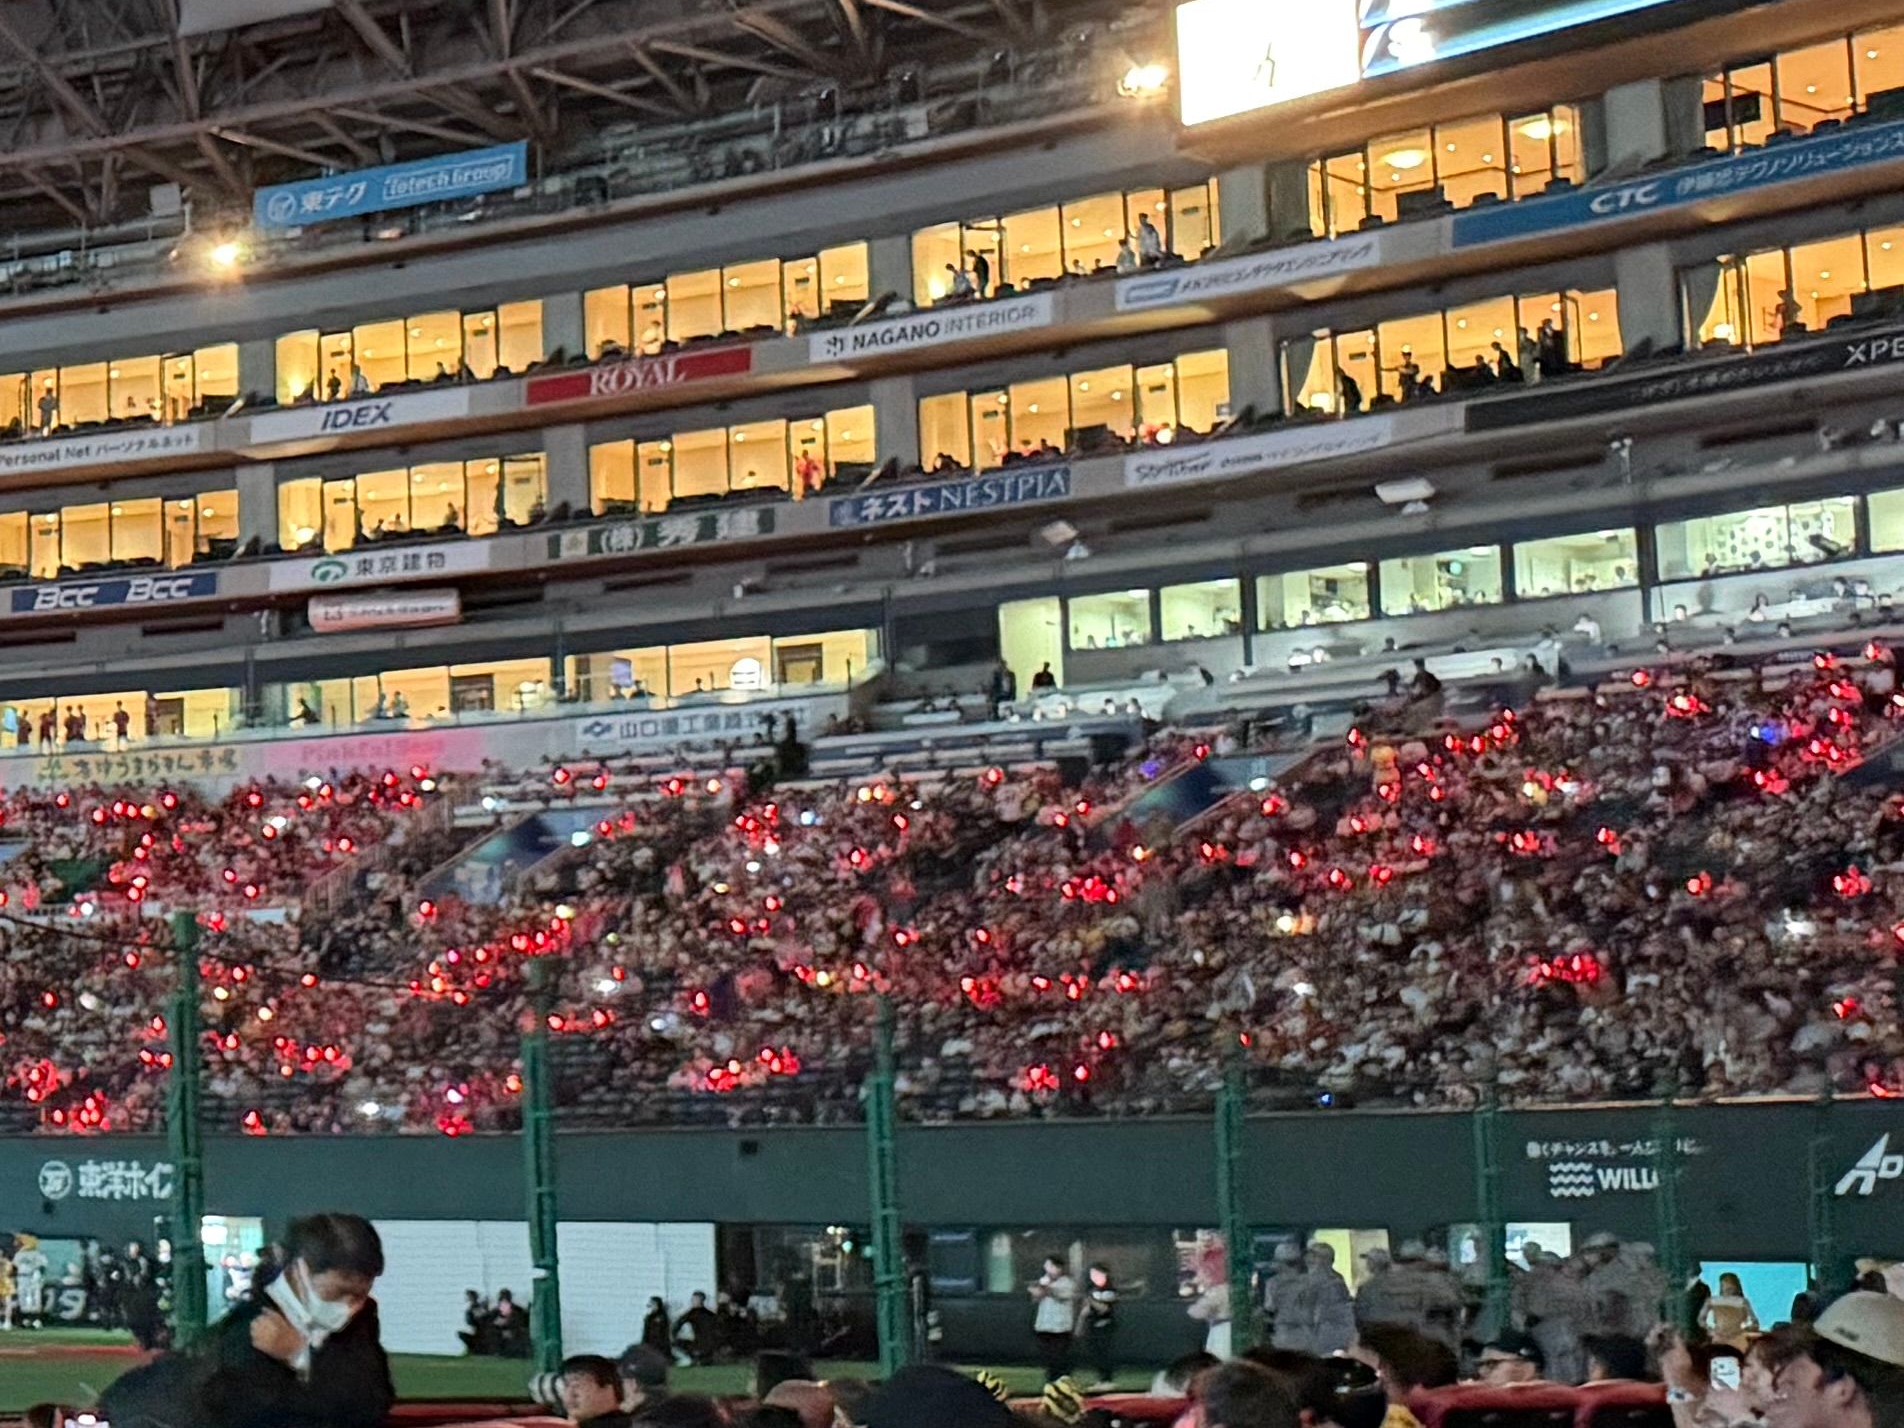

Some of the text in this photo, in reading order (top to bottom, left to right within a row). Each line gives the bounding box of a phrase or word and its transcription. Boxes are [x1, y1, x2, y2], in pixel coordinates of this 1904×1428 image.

[298, 180, 368, 215] 東テク
[1590, 180, 1660, 214] CTC
[852, 306, 1038, 351] NAGANO INTERIOR
[590, 360, 689, 395] ROYAL
[321, 403, 392, 431] IDEX
[64, 445, 90, 459] Net
[860, 473, 1068, 521] ネスト NESTPIA
[353, 552, 447, 579] 東京建物
[34, 577, 193, 610] BCC BCC
[1596, 1167, 1660, 1191] WILL
